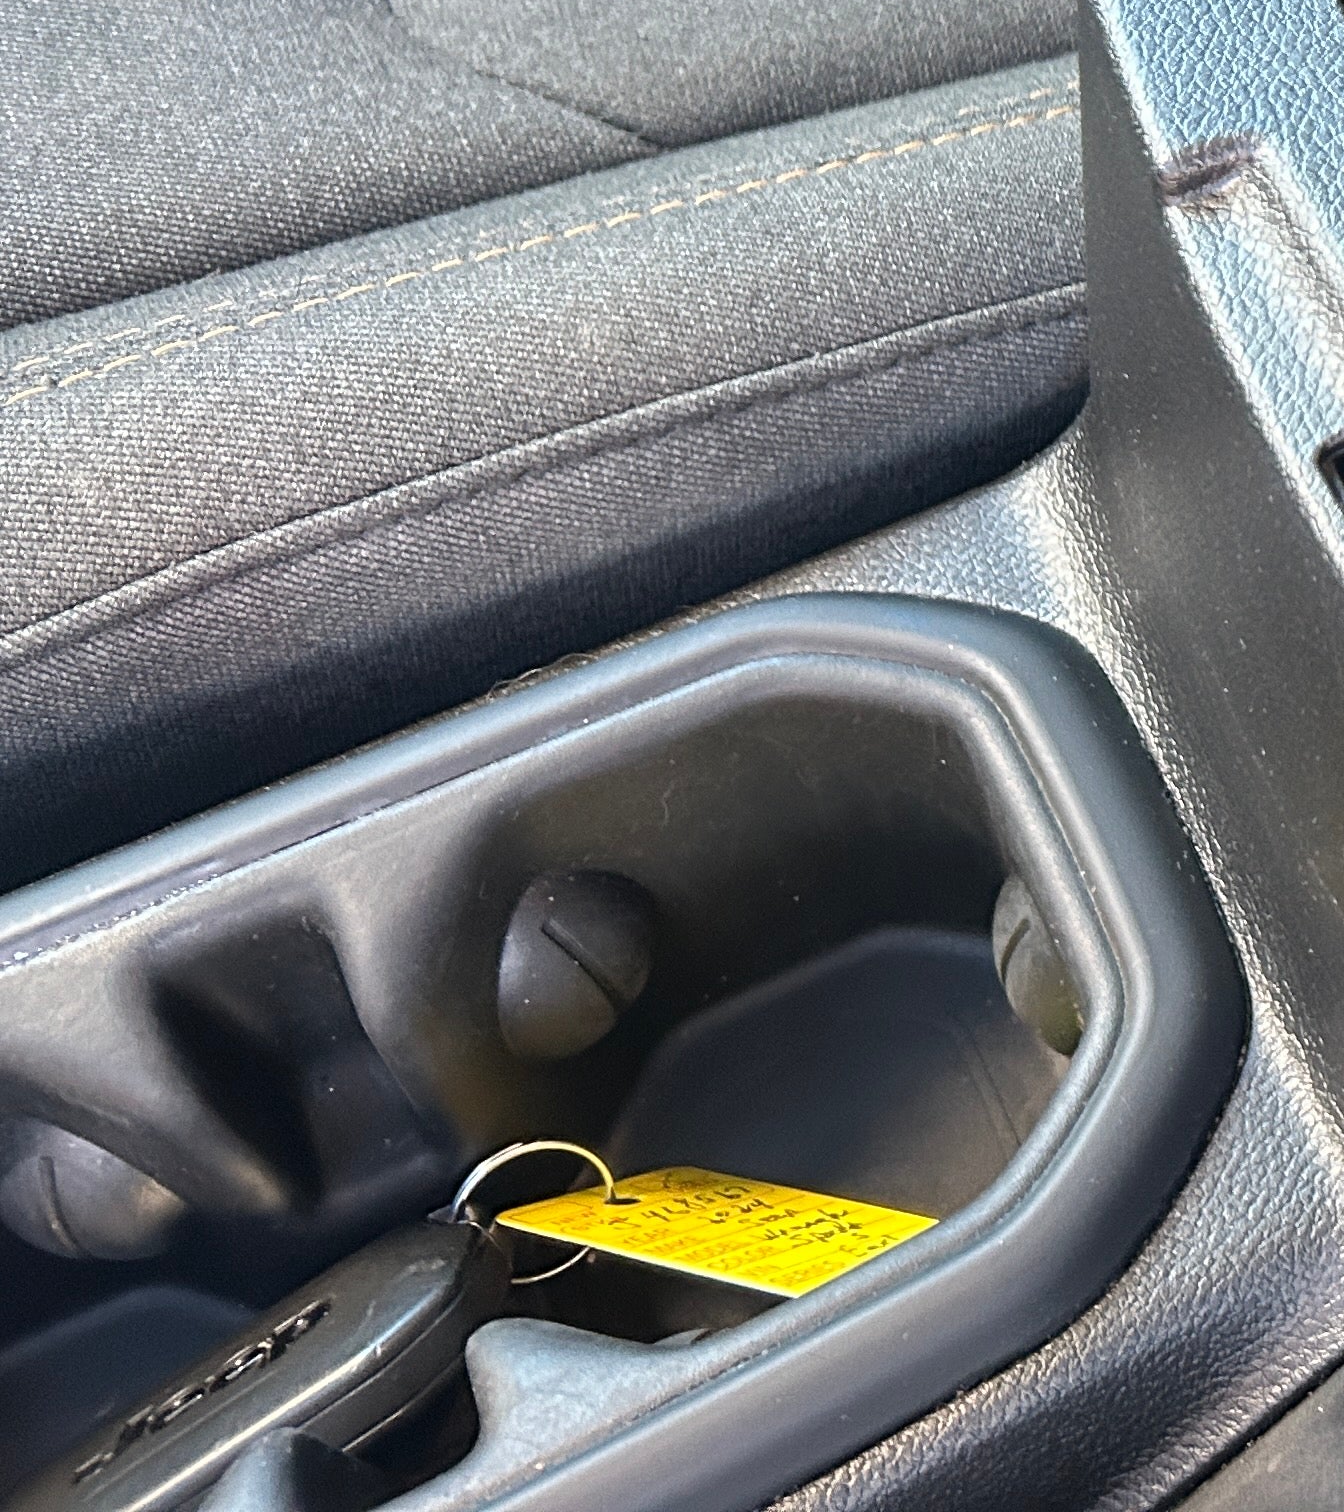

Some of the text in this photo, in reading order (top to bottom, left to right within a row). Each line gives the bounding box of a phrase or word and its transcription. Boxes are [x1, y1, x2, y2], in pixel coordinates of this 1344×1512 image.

[709, 1199, 774, 1224] 2024
[622, 1229, 671, 1246] YEAR
[674, 1242, 751, 1262] MODEL
[706, 1246, 774, 1270] COLOR
[769, 1261, 846, 1287] SERIES
